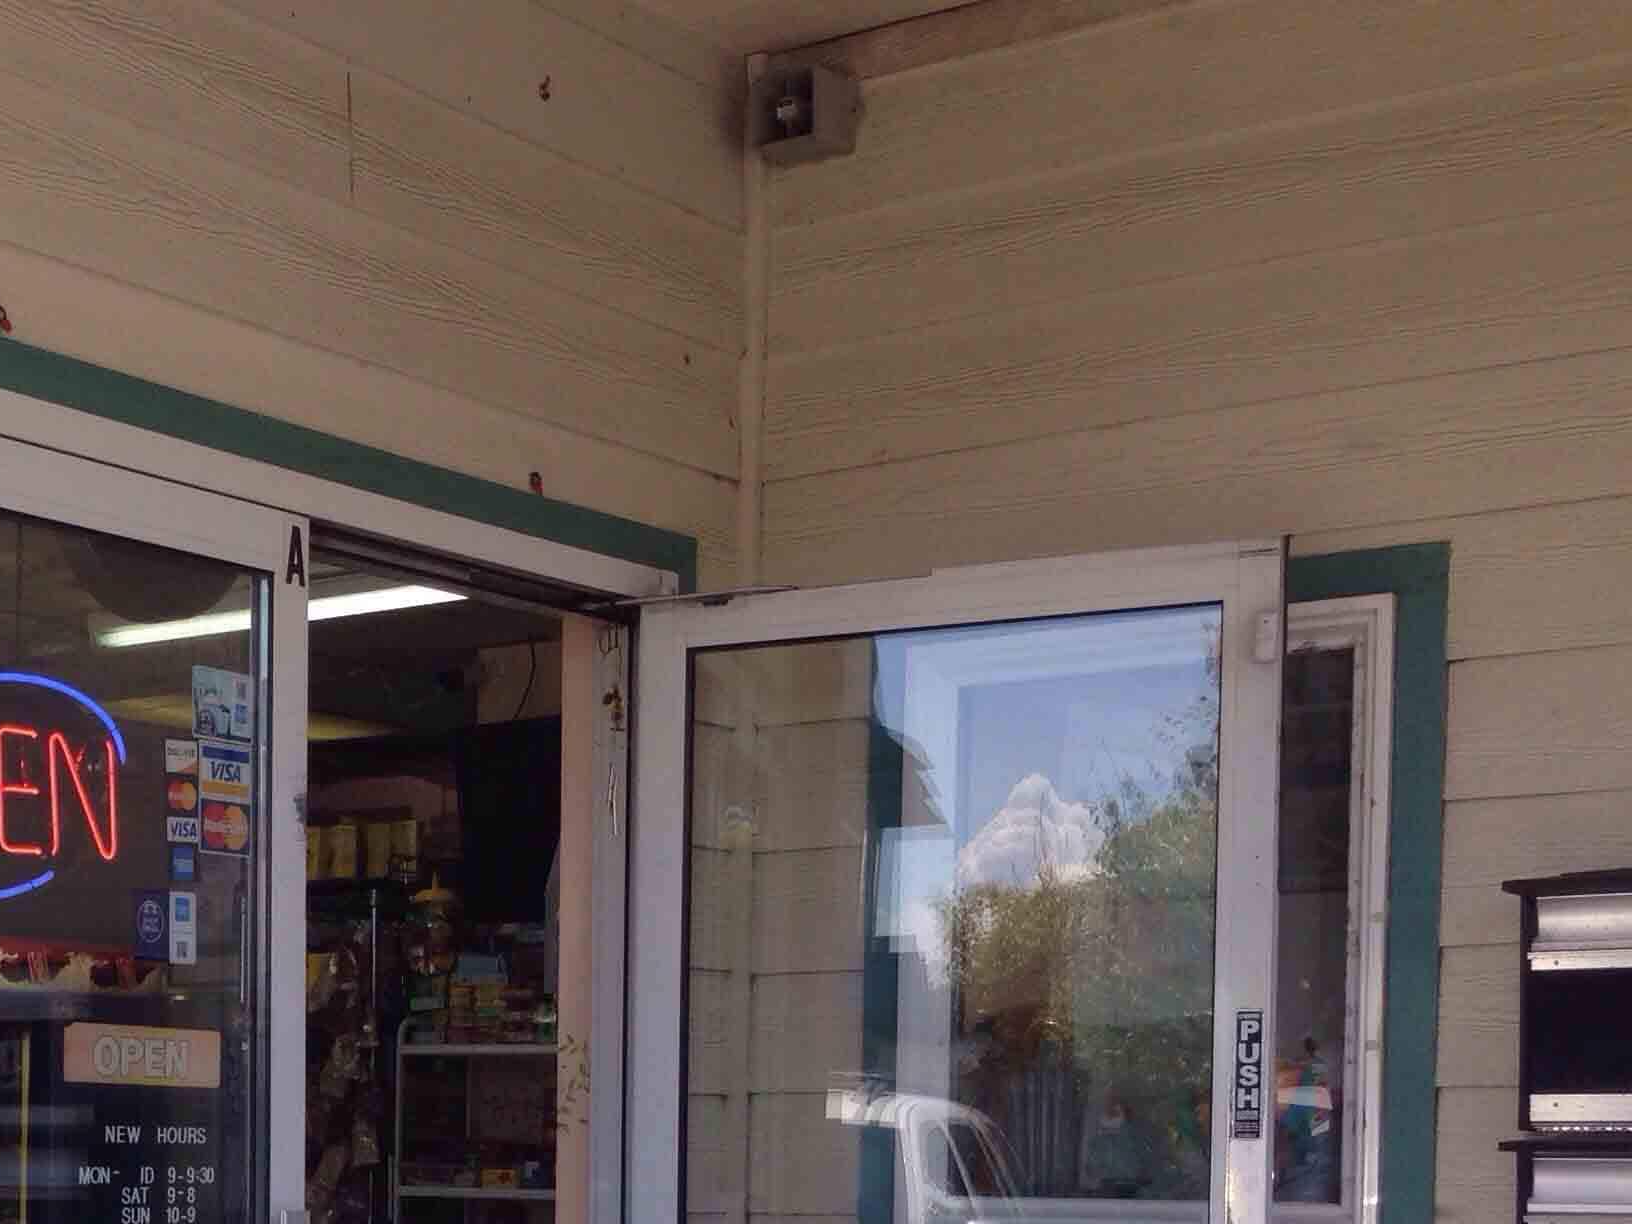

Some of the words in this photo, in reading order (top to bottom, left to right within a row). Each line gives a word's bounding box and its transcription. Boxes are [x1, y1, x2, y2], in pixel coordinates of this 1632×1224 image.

[286, 525, 305, 587] A
[210, 761, 241, 782] VISA
[171, 822, 197, 838] VISA
[92, 1035, 190, 1079] OPEN
[1237, 1020, 1260, 1109] PUSH
[104, 1125, 141, 1144] NEW
[157, 1127, 207, 1144] HOURS
[121, 1186, 151, 1205] SAT
[121, 1207, 151, 1224] SUN
